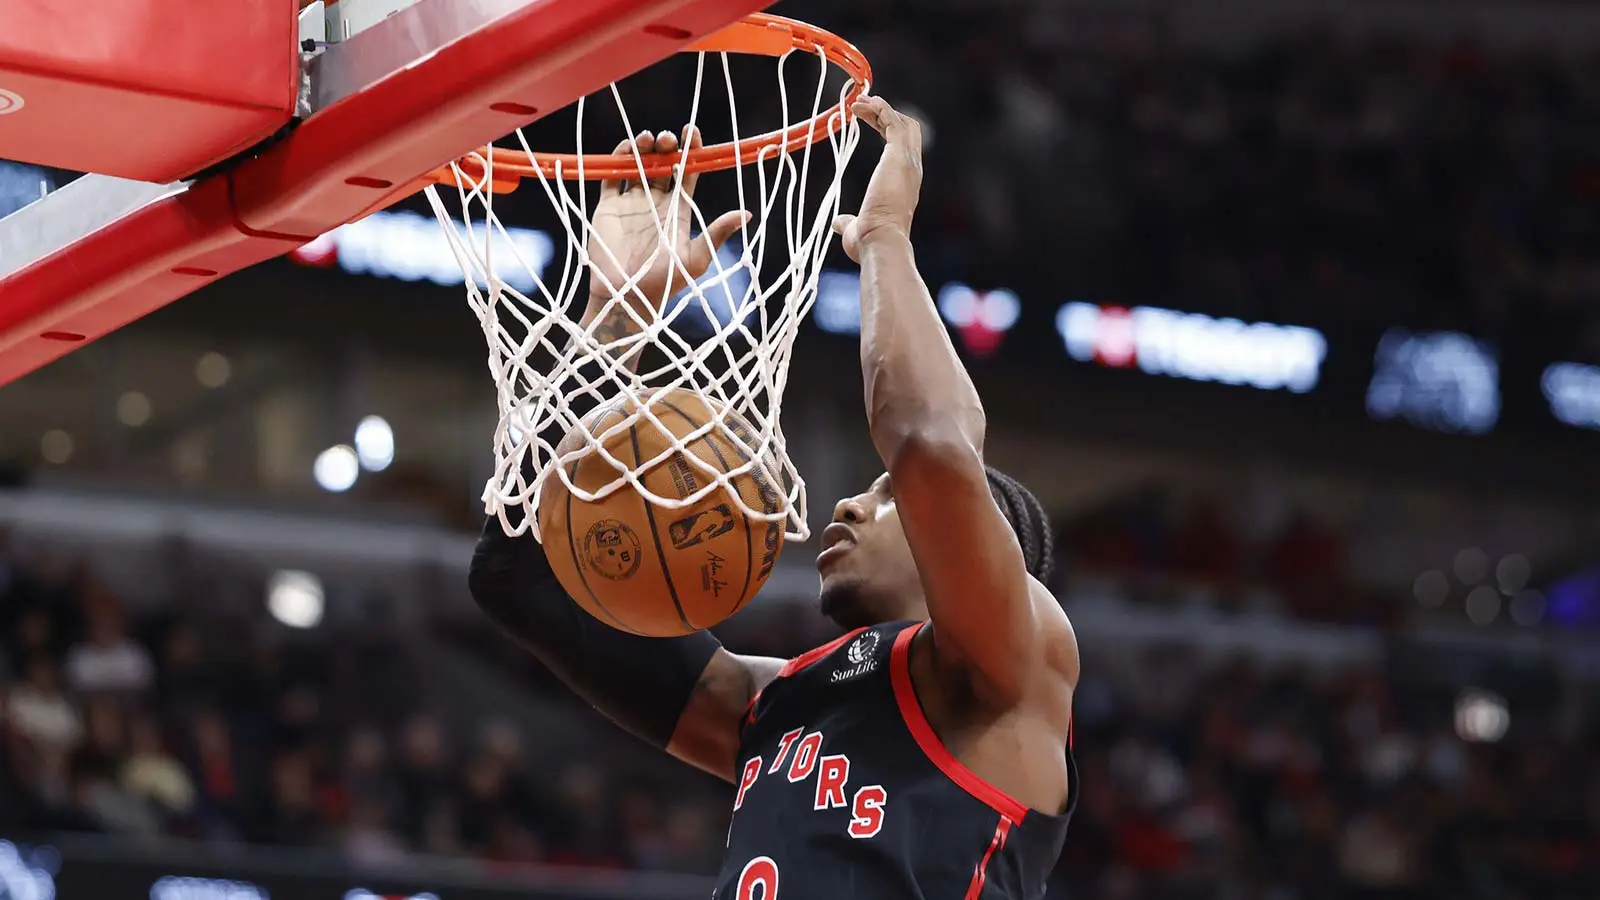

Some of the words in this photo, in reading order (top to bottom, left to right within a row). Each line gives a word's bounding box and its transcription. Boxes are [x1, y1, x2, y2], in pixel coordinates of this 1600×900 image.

[830, 669, 854, 683] Sun
[855, 658, 878, 676] Life
[727, 726, 887, 838] PTORS
